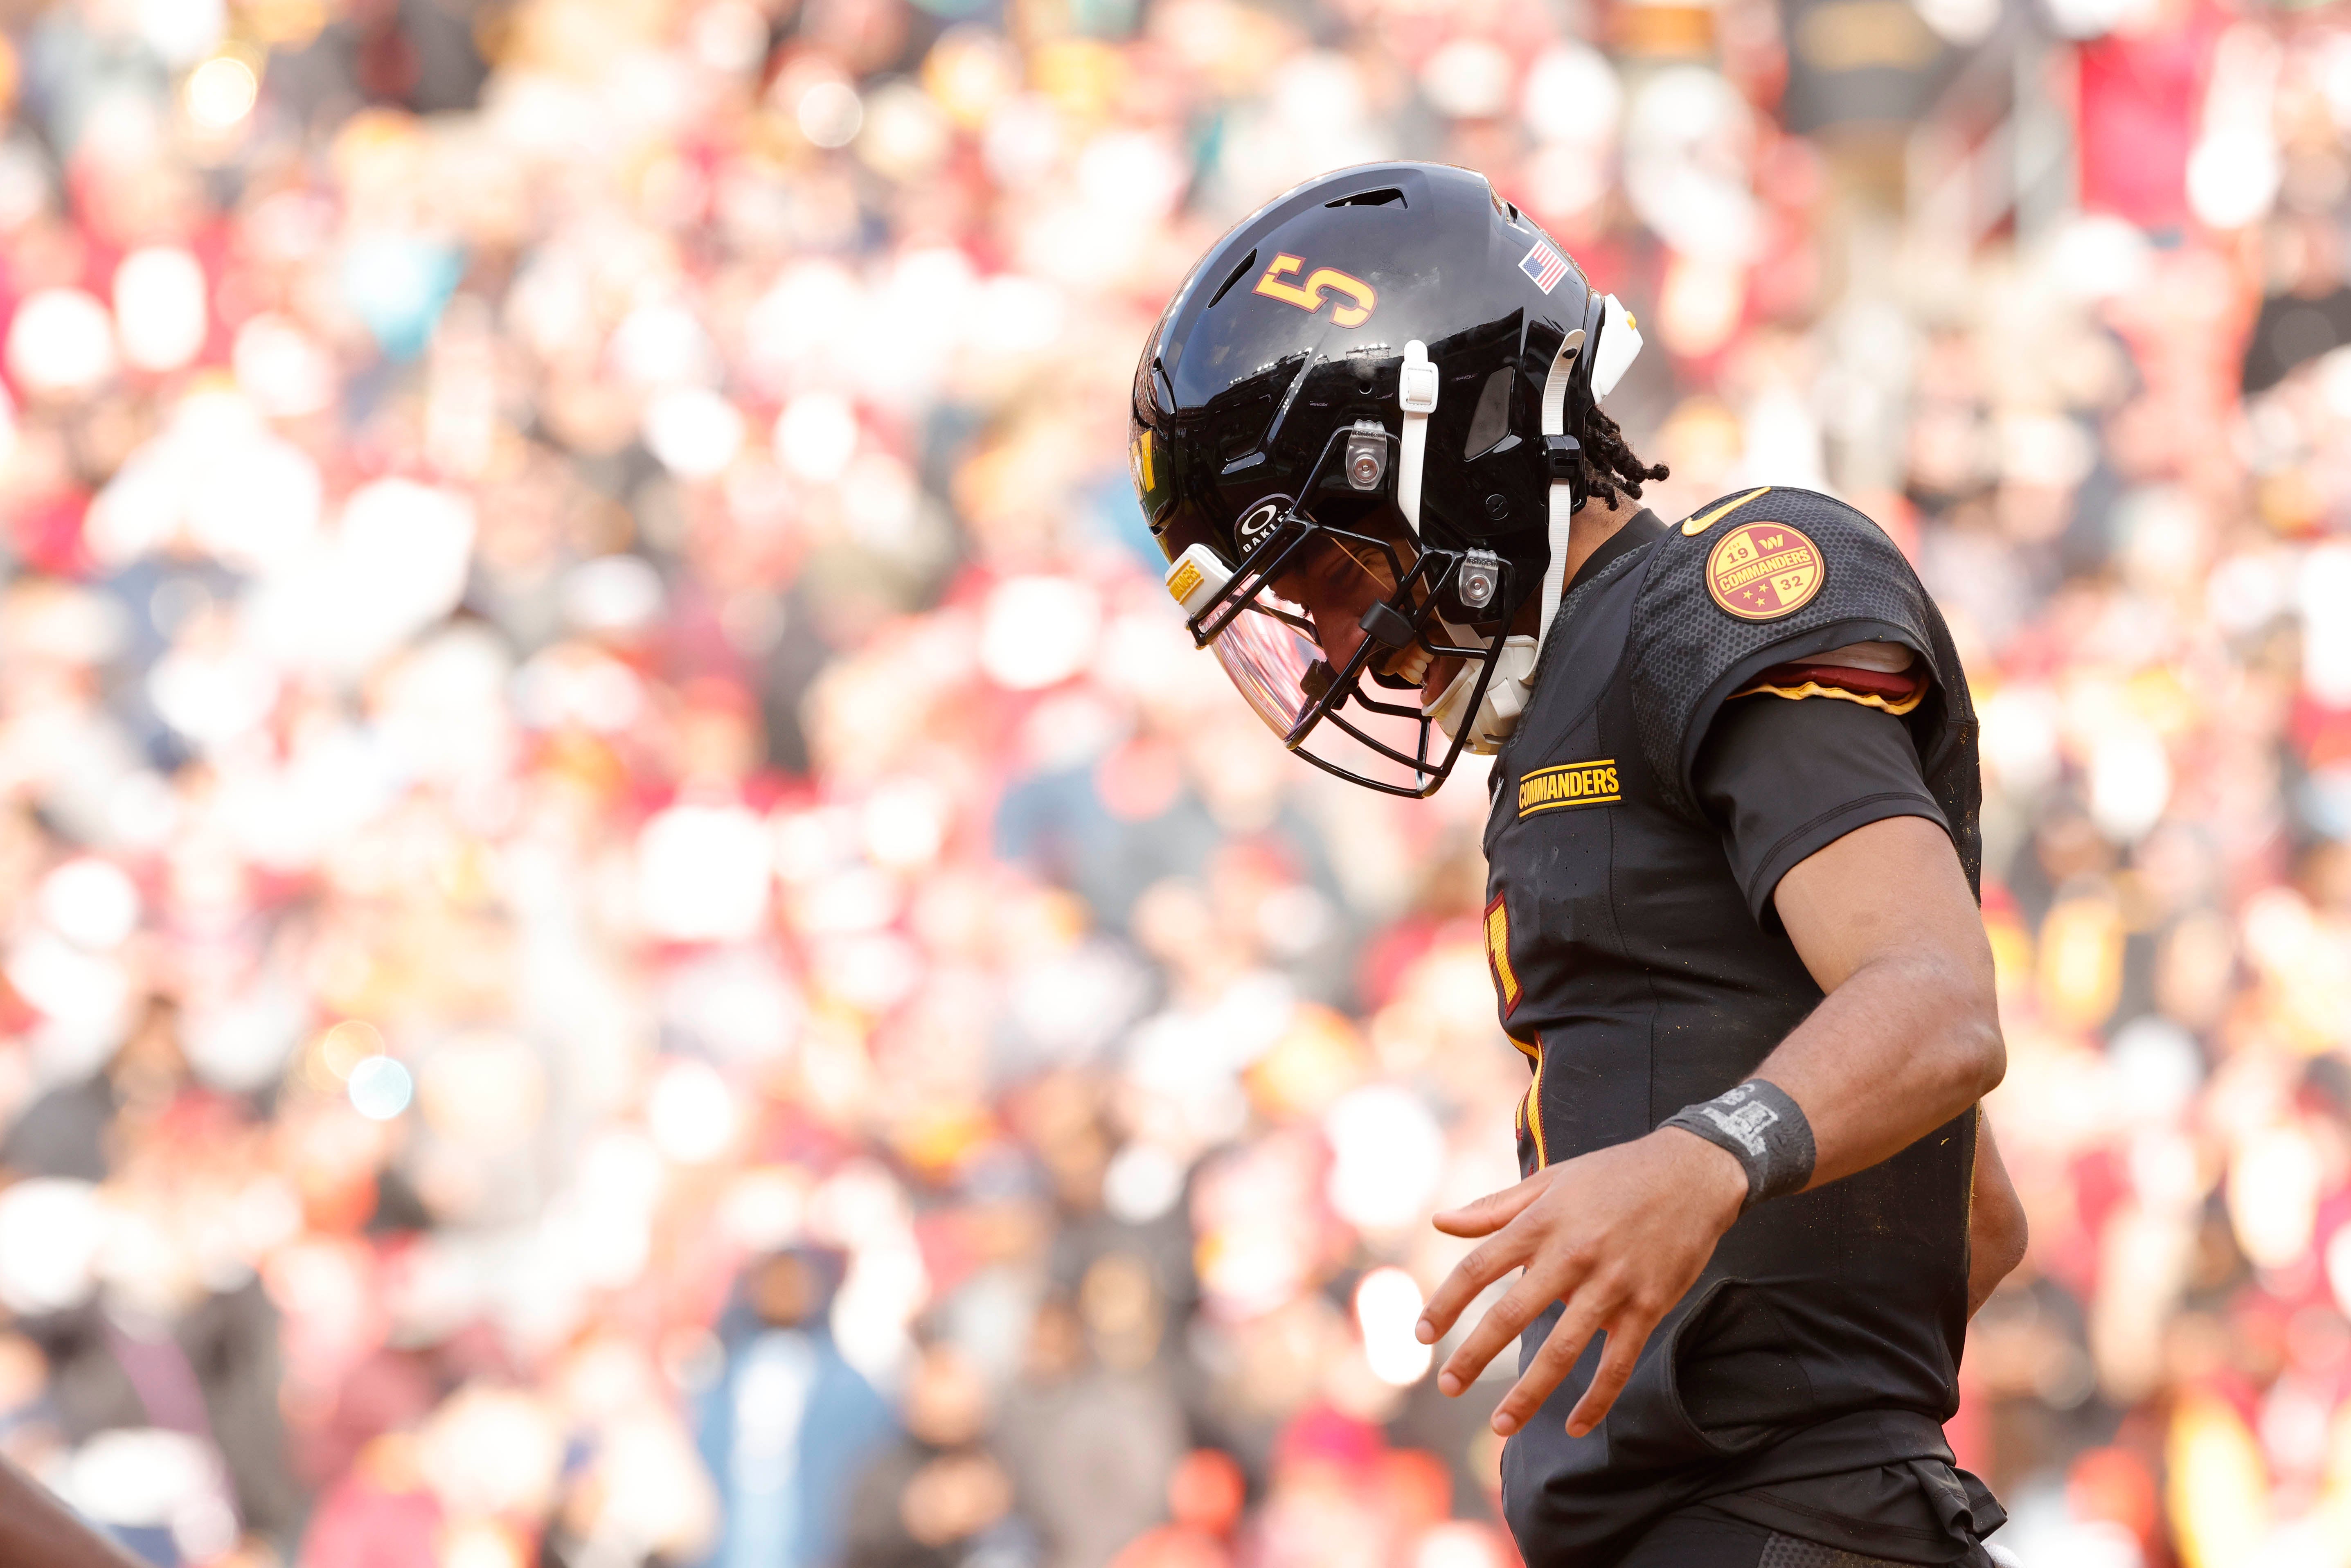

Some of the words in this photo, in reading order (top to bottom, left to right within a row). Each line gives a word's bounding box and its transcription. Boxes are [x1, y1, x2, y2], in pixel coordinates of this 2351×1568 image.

[1251, 251, 1378, 329] 5
[1355, 430, 1381, 439] Ridde
[1727, 547, 1748, 564] 19
[1719, 550, 1811, 591] COMMANDERS
[1780, 576, 1803, 590] 32
[1519, 767, 1619, 809] COMMANDERS
